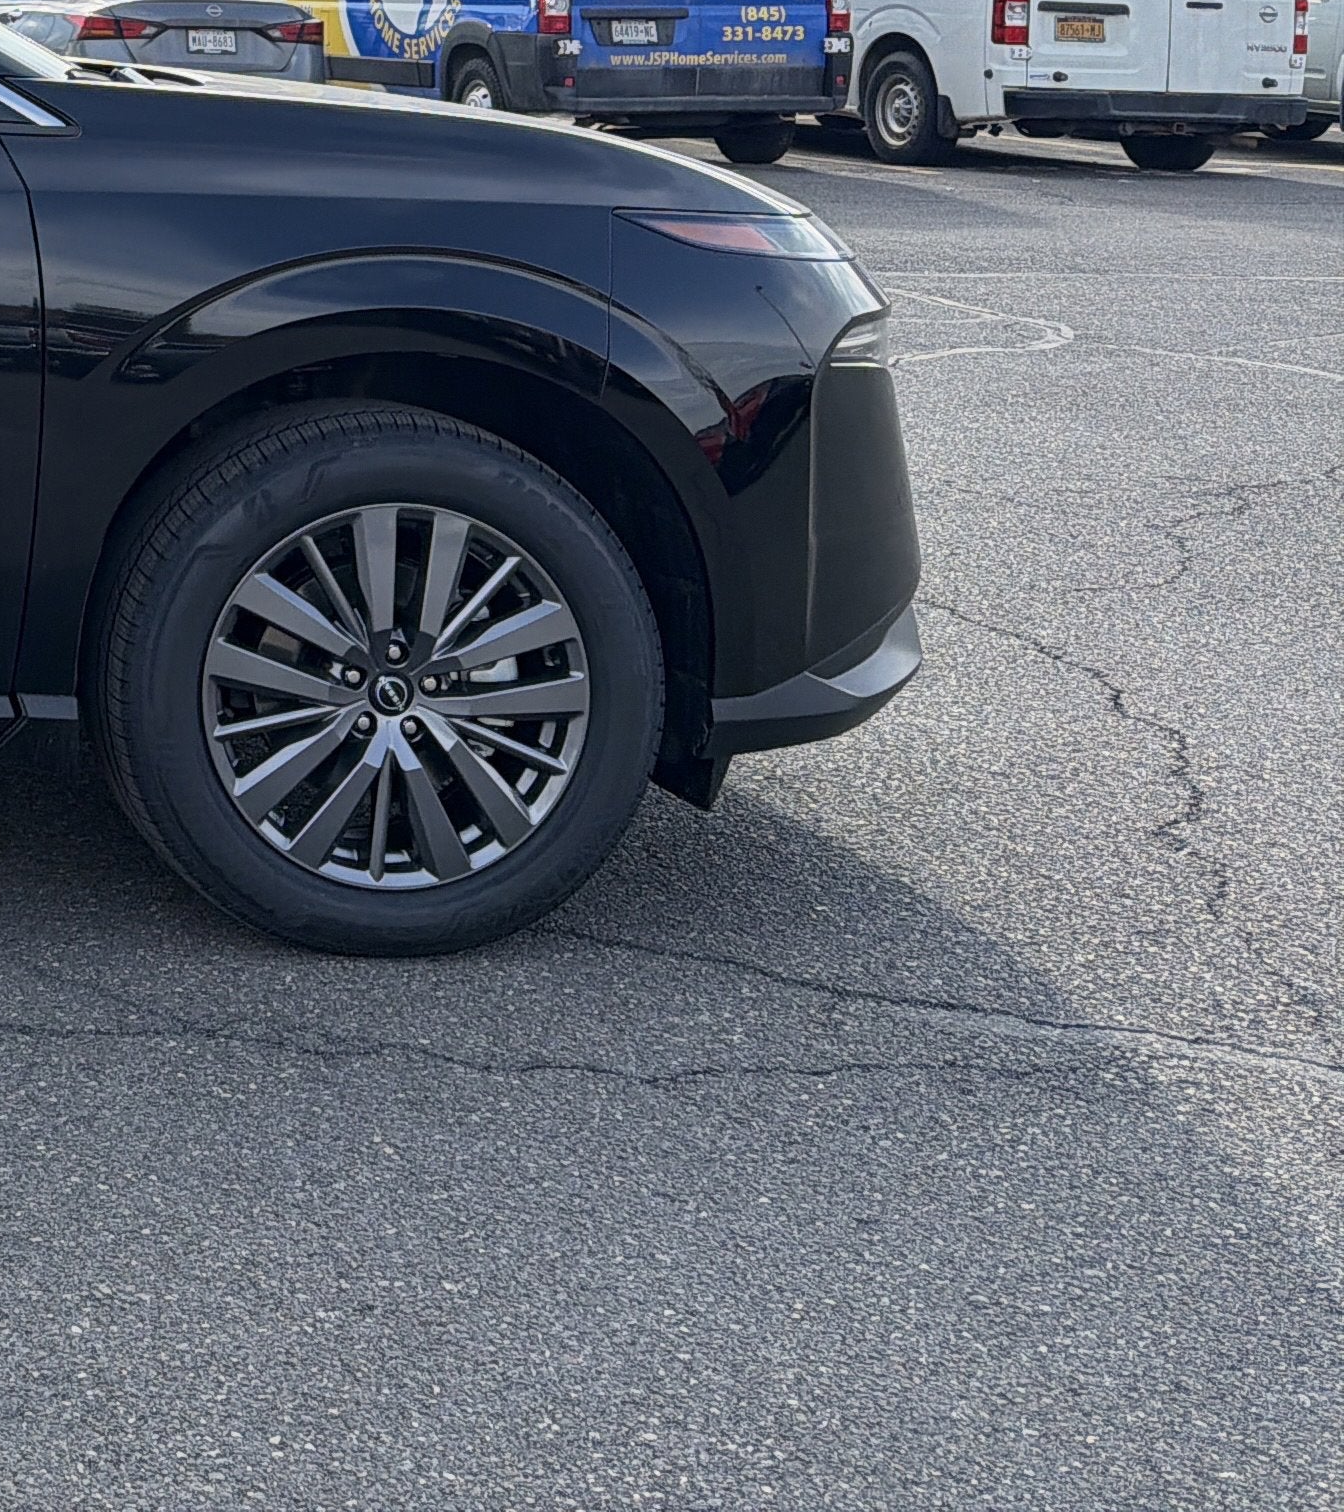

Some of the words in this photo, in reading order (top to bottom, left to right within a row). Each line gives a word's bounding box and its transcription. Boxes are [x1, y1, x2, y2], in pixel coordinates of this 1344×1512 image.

[740, 6, 786, 23] (845)
[722, 26, 805, 41] 331-8473
[610, 50, 787, 66] www.JSPHomeServices.com
